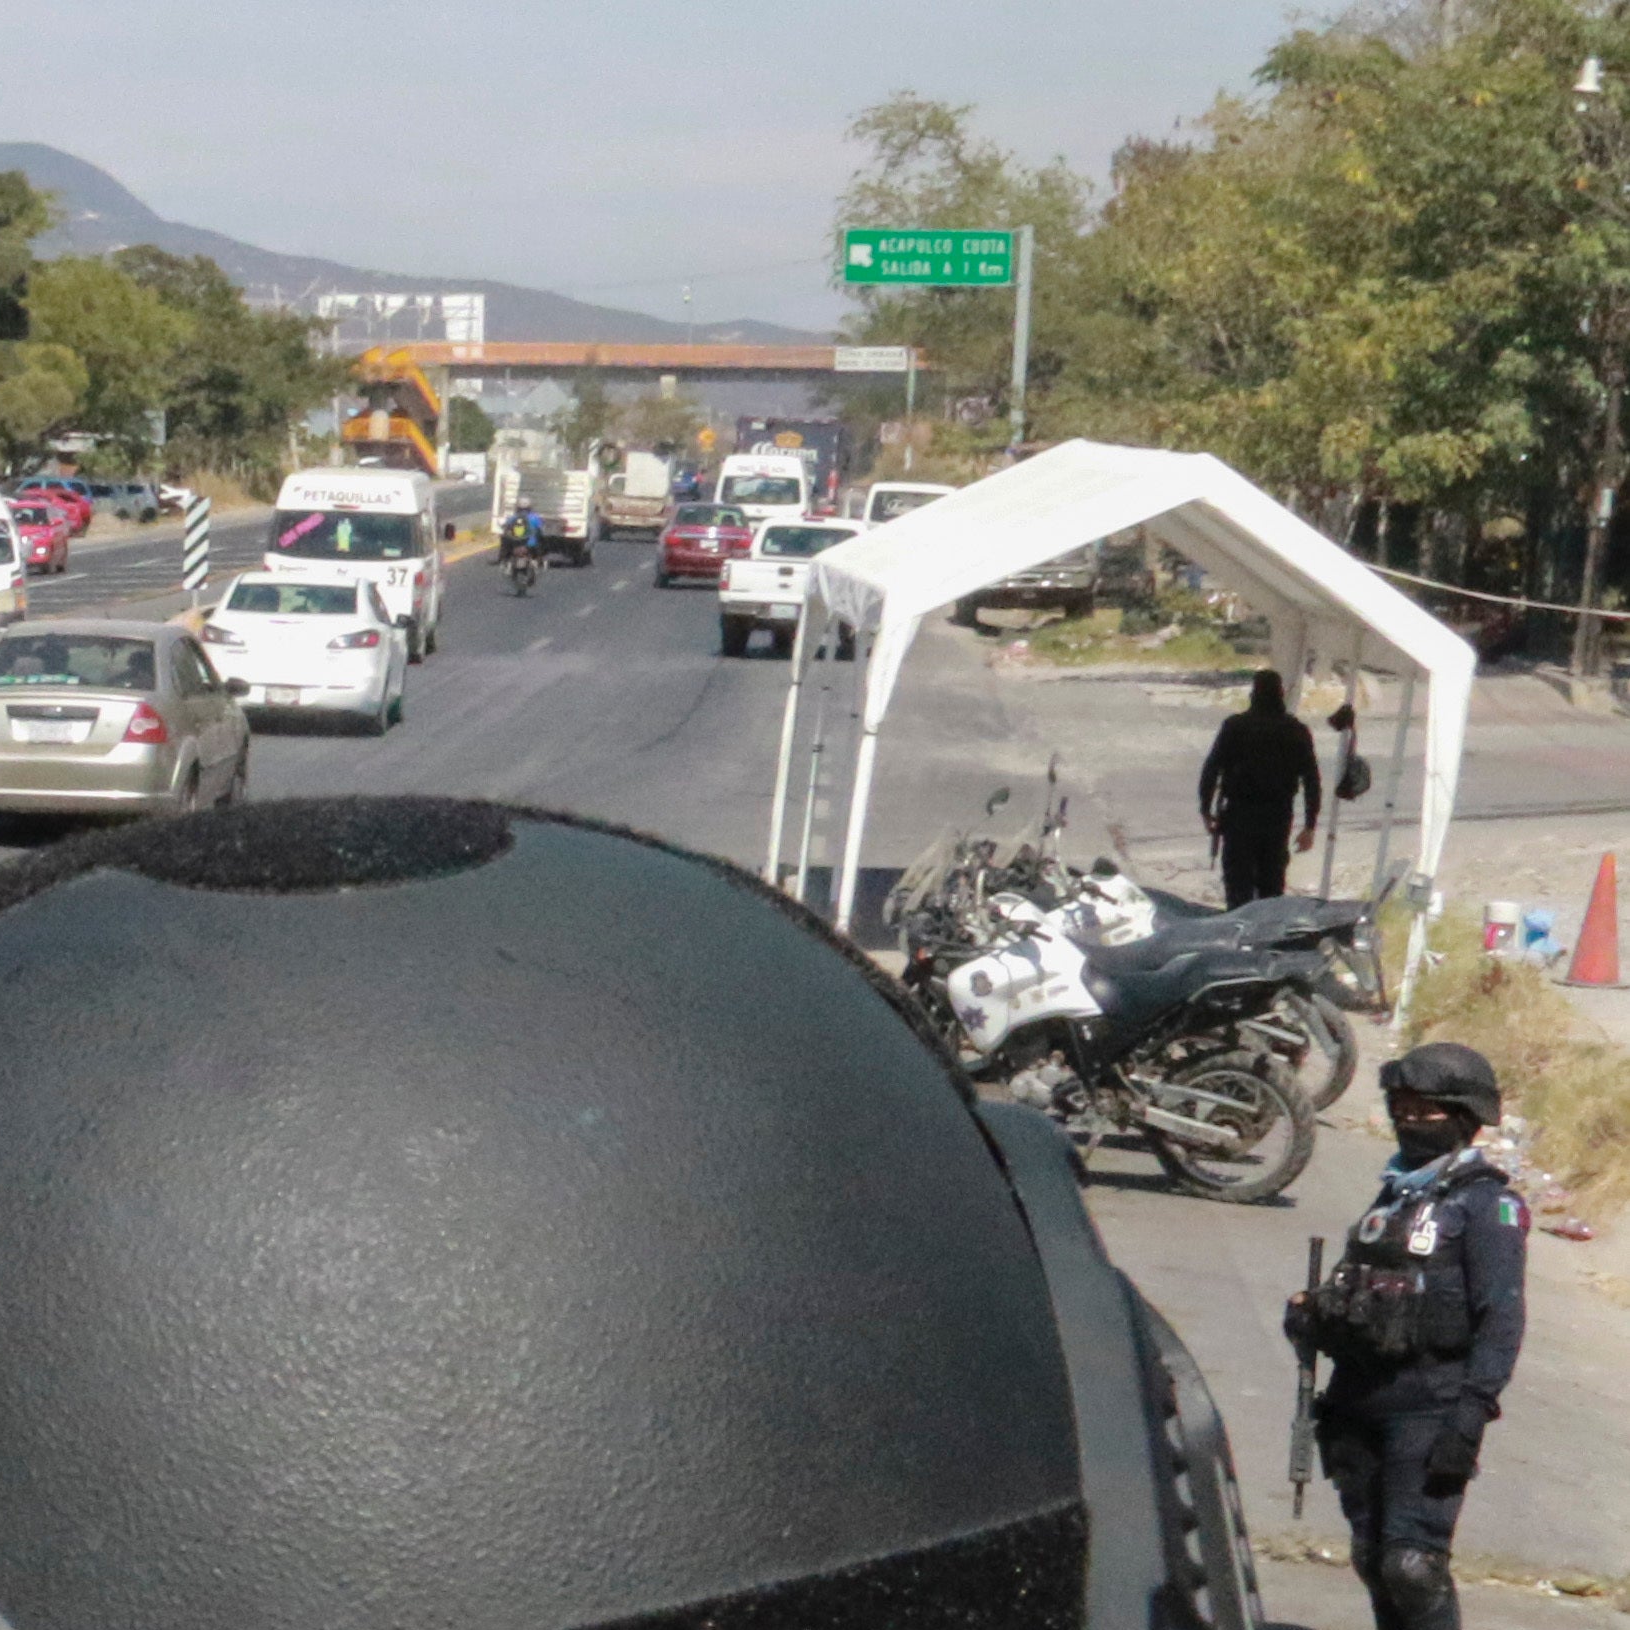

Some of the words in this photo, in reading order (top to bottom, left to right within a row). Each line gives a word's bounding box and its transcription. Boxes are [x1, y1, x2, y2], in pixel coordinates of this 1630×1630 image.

[878, 237, 953, 254] ACAPULCO
[962, 239, 1006, 254] CUOTA
[881, 260, 932, 275] SALIDA
[942, 261, 952, 275] A
[963, 262, 970, 275] 1
[978, 262, 1004, 276] Km
[303, 490, 392, 504] PETAQUILLAS
[387, 568, 409, 585] 37
